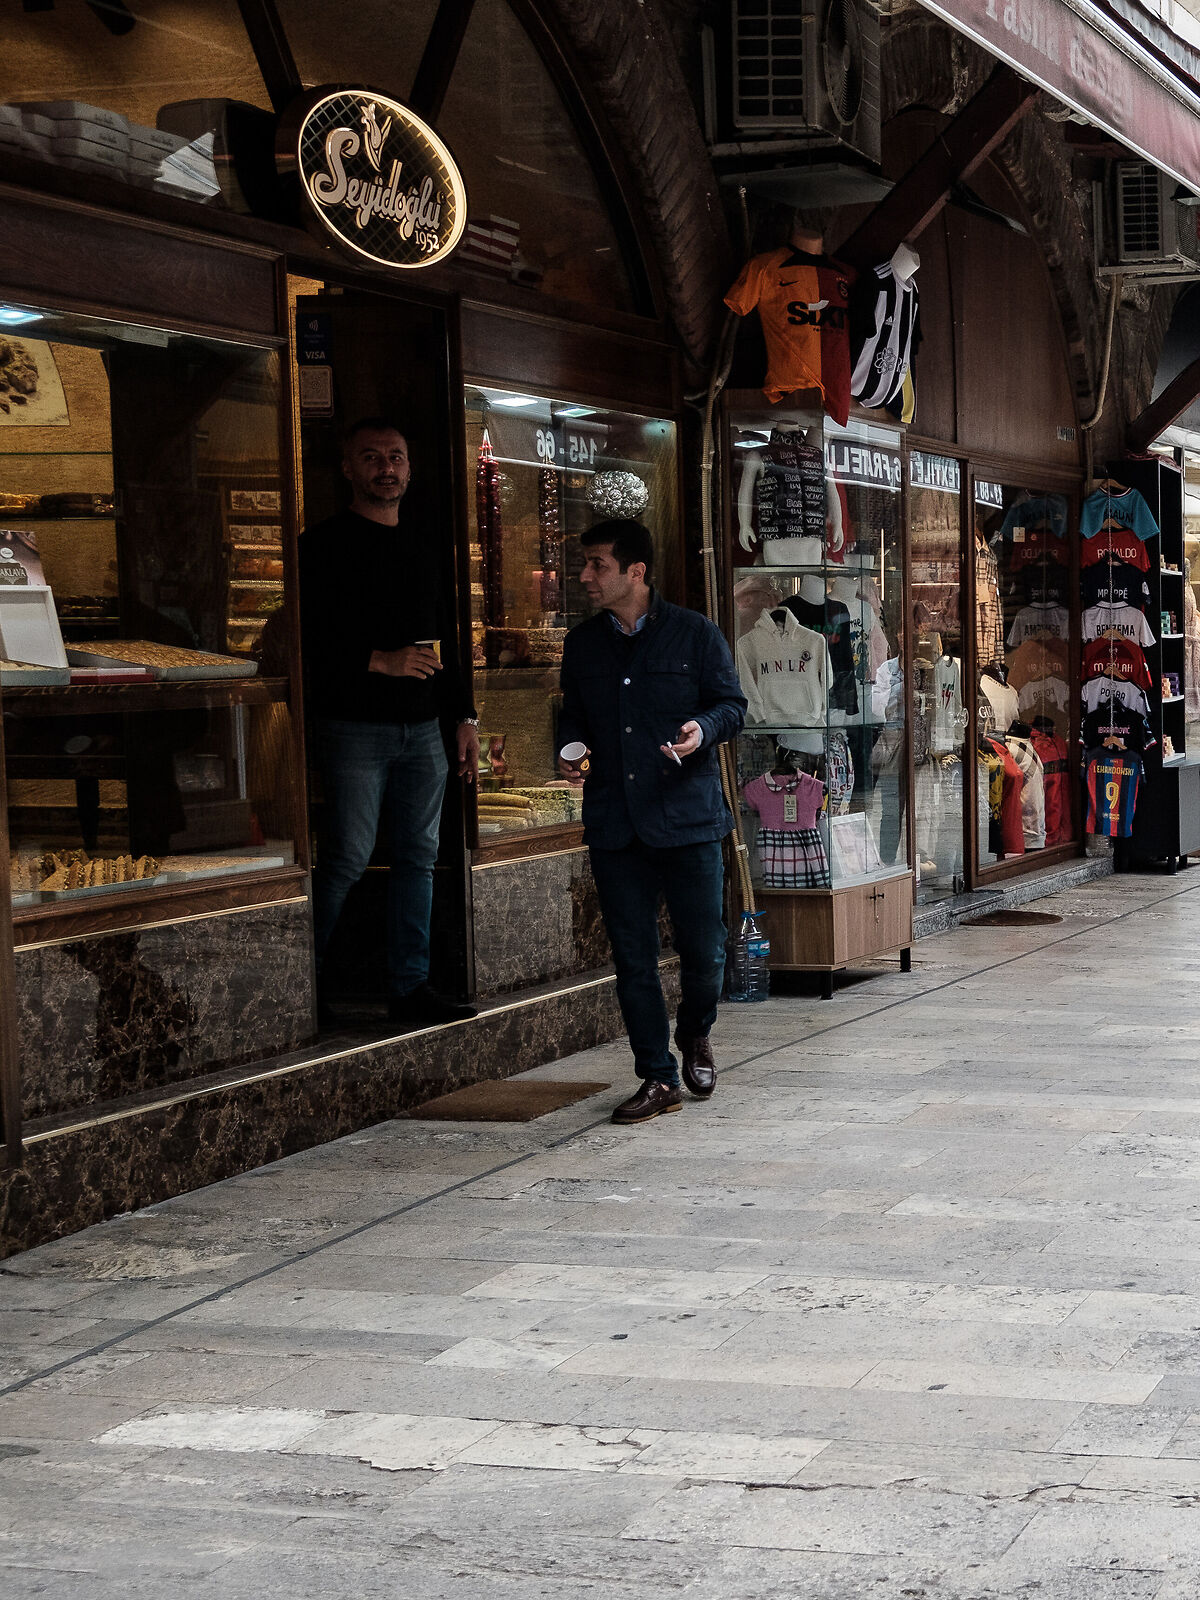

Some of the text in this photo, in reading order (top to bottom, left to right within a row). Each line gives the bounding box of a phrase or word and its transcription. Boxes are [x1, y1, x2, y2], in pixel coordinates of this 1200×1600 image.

[414, 229, 440, 253] 1952
[305, 351, 326, 359] VISA
[1097, 547, 1137, 559] ROALDO
[0, 568, 26, 577] AKLAVA
[1105, 781, 1120, 809] 9
